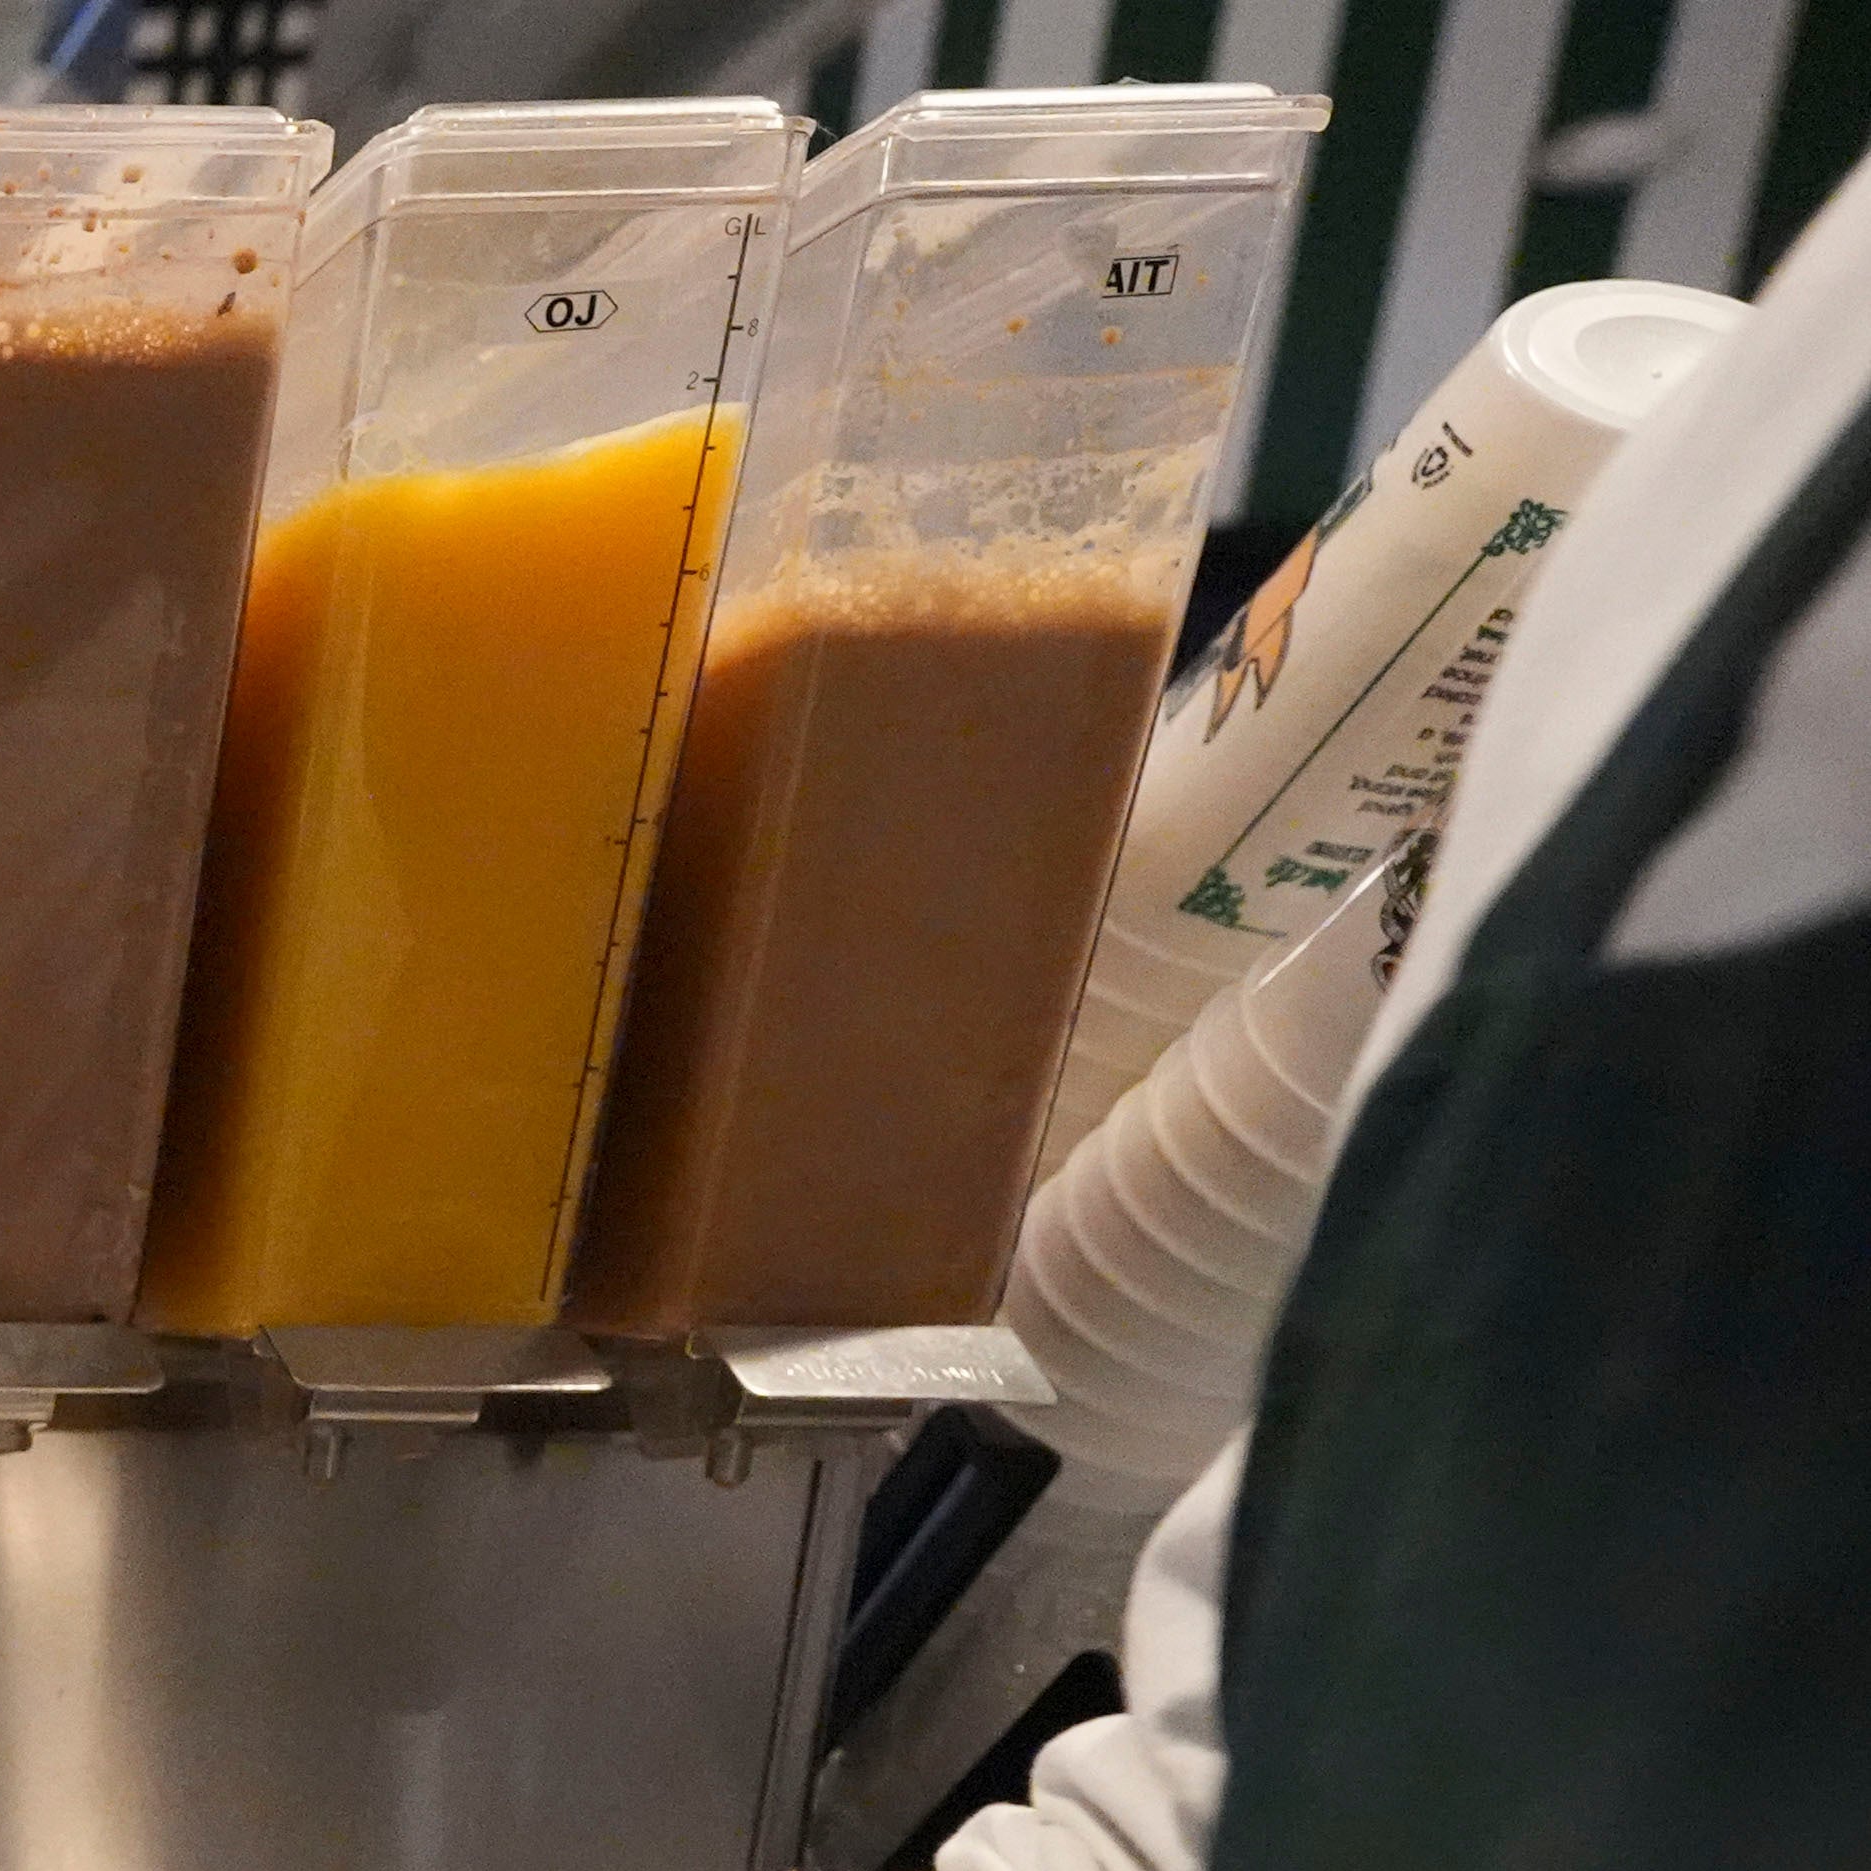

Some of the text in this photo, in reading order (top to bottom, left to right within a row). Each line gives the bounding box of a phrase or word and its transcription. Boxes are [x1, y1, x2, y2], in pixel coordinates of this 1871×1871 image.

[724, 216, 742, 237] G
[754, 216, 767, 236] L
[545, 294, 597, 328] OJ
[747, 317, 759, 338] 8
[686, 370, 700, 391] 2
[698, 562, 710, 582] 6
